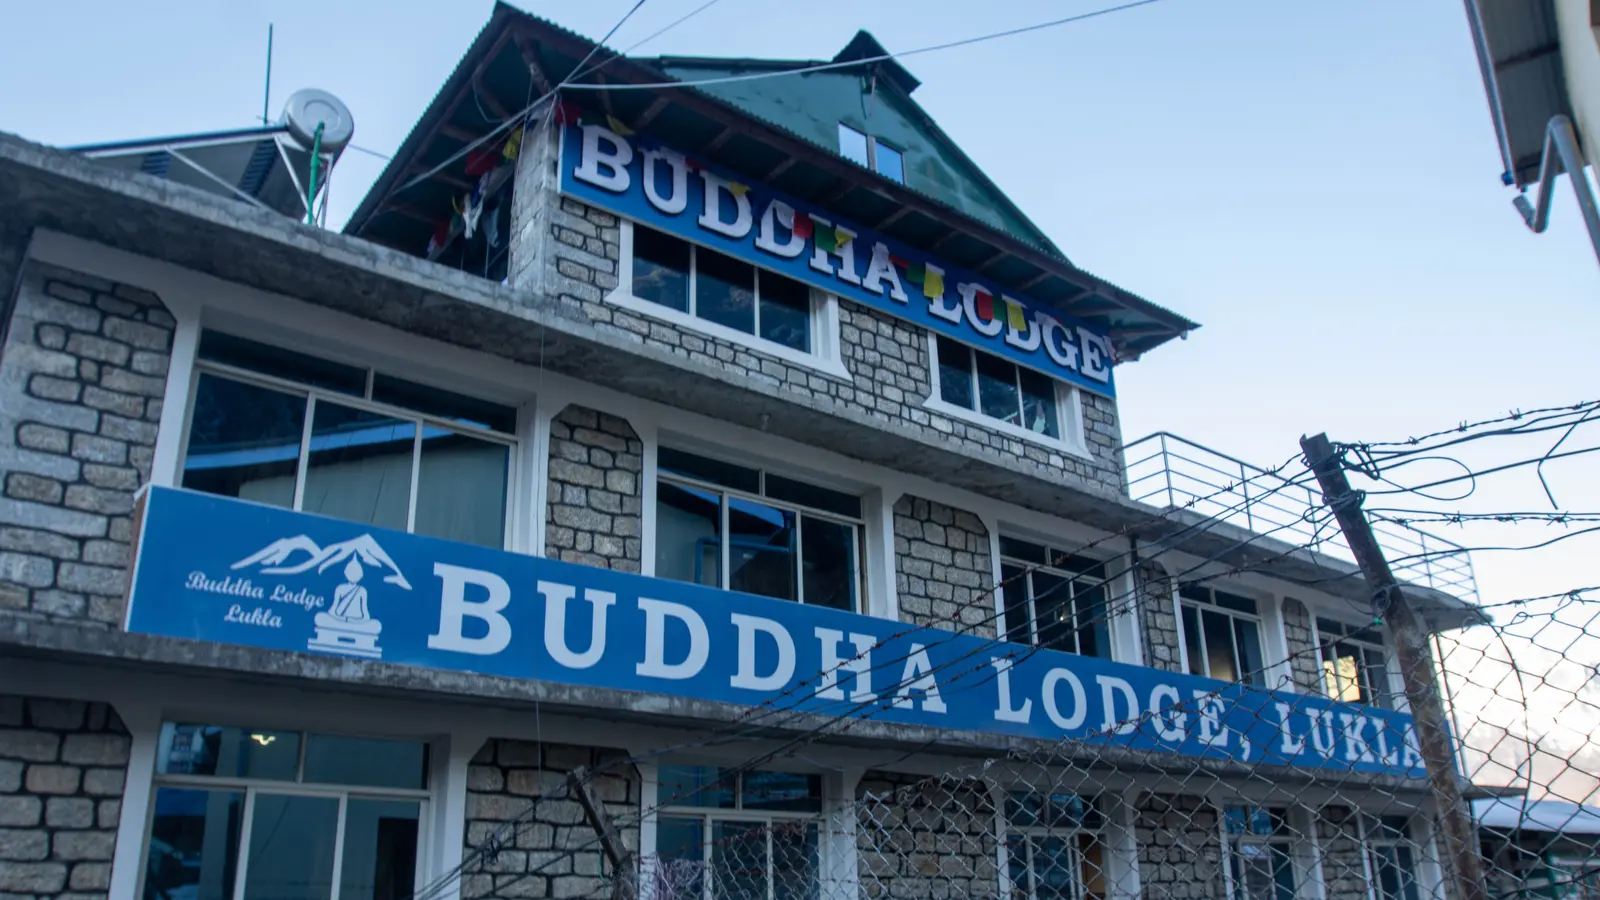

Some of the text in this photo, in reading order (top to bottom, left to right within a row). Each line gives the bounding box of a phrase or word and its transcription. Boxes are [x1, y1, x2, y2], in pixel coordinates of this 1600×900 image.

[574, 122, 1110, 384] BUDDHA LODGE
[185, 570, 325, 611] Buddha Lodge
[224, 604, 283, 628] Lukla
[427, 561, 1427, 769] BUDDHA LODGE, LUKLA
